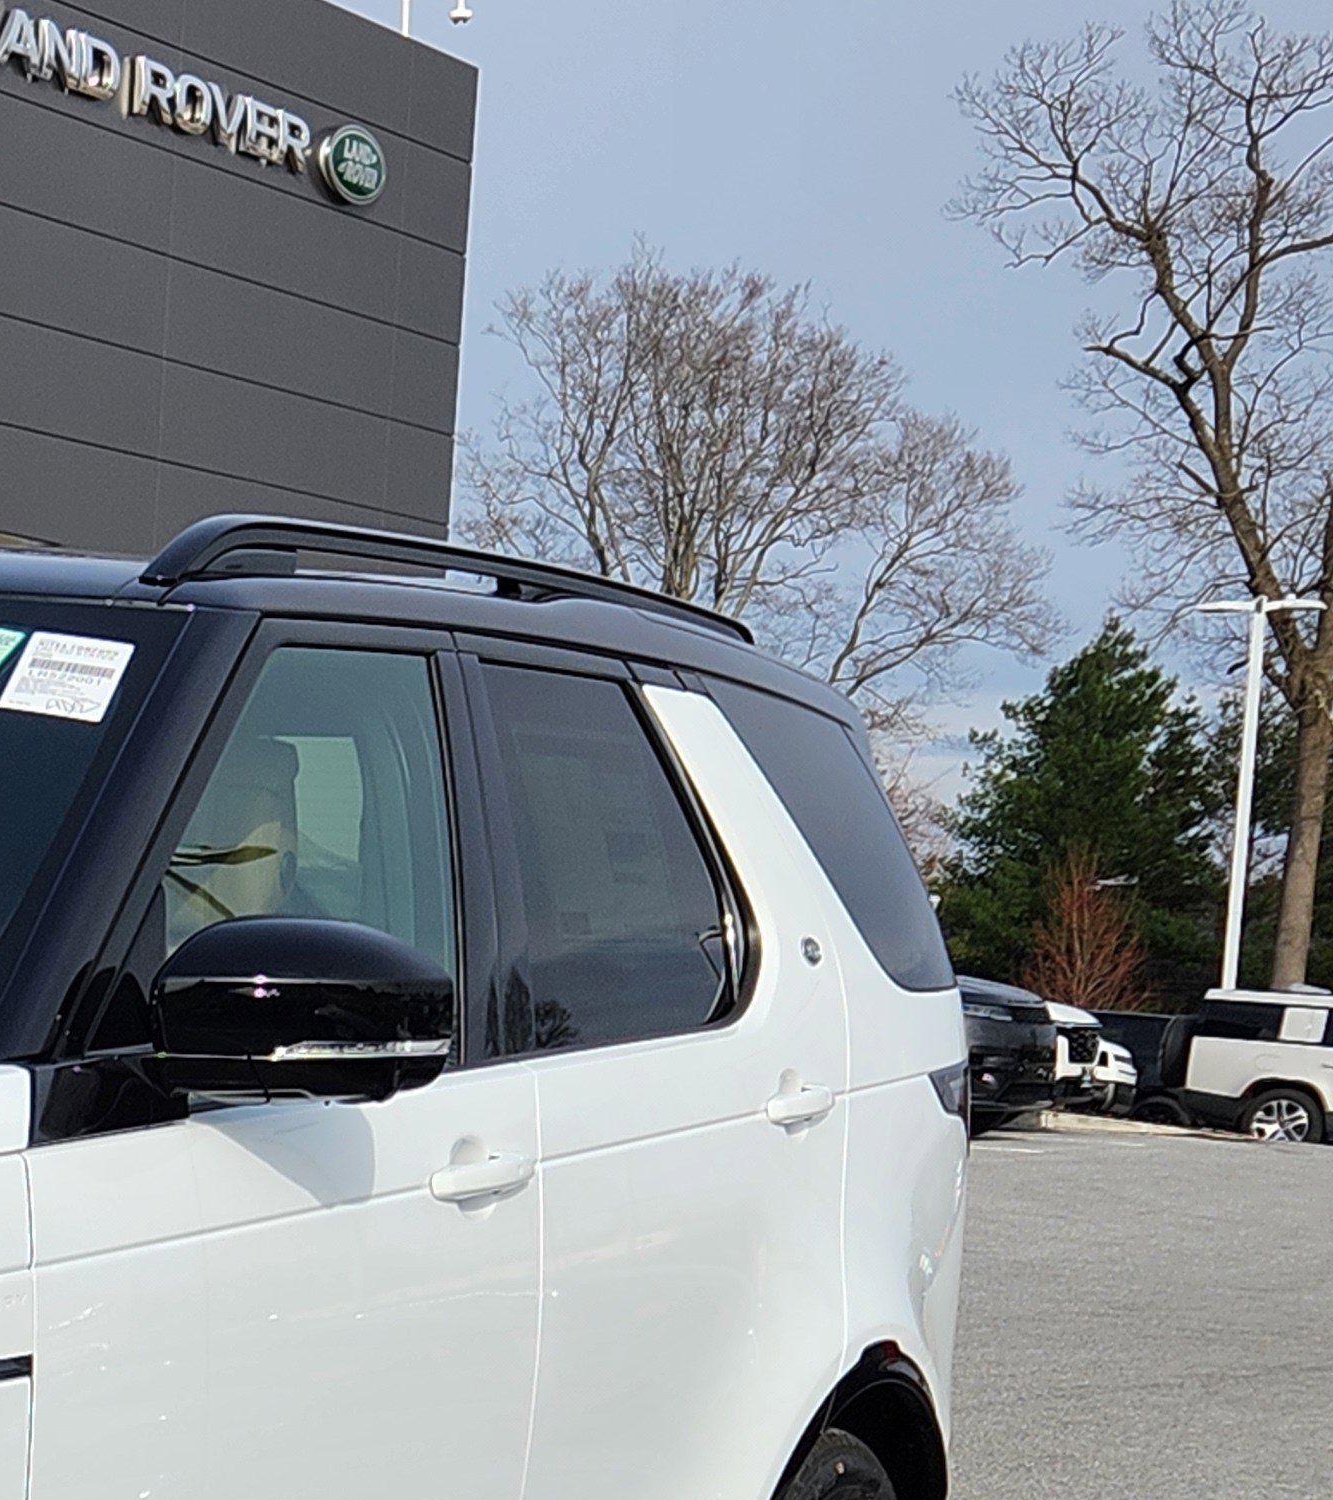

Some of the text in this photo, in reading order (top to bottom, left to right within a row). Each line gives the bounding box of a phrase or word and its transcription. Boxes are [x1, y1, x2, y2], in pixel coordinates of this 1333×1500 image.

[132, 55, 310, 173] ROVER
[344, 138, 375, 165] LAND
[342, 160, 378, 190] ROVER
